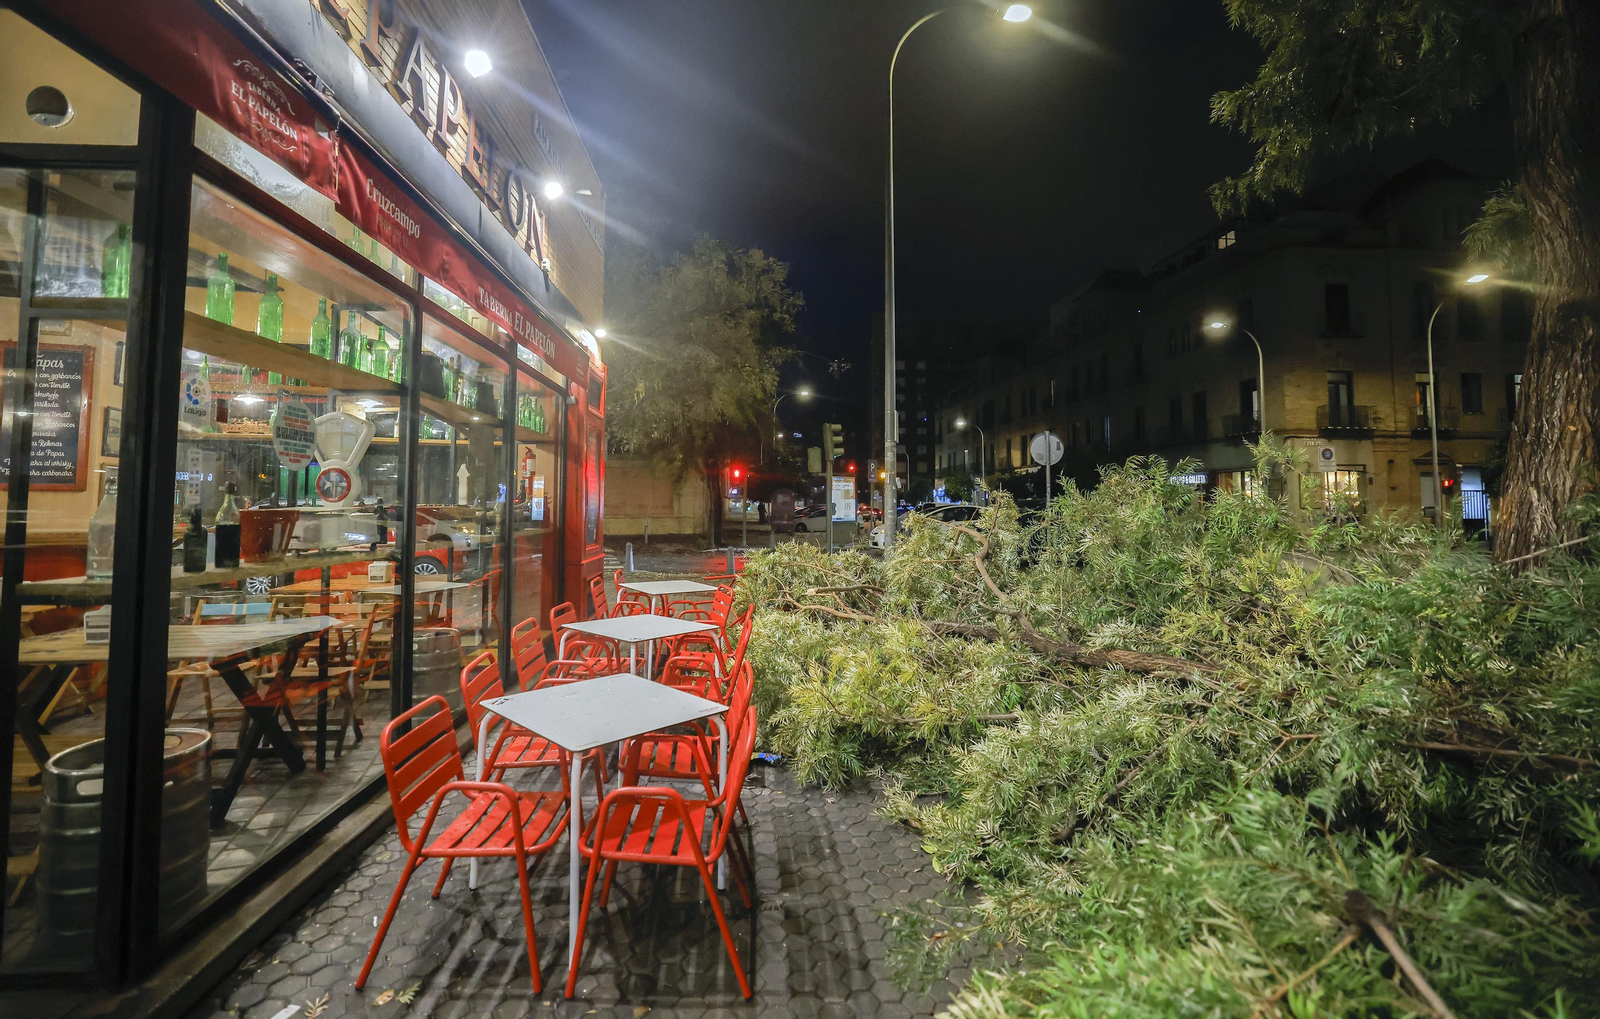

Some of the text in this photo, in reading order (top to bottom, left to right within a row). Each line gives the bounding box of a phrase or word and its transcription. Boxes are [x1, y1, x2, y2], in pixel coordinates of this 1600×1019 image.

[231, 79, 298, 141] EL PAPELÓN
[247, 81, 281, 115] TABERNA
[367, 178, 420, 239] Cruzcampo
[478, 286, 556, 360] TABERNA EL PAPELÓN
[36, 354, 64, 371] apas
